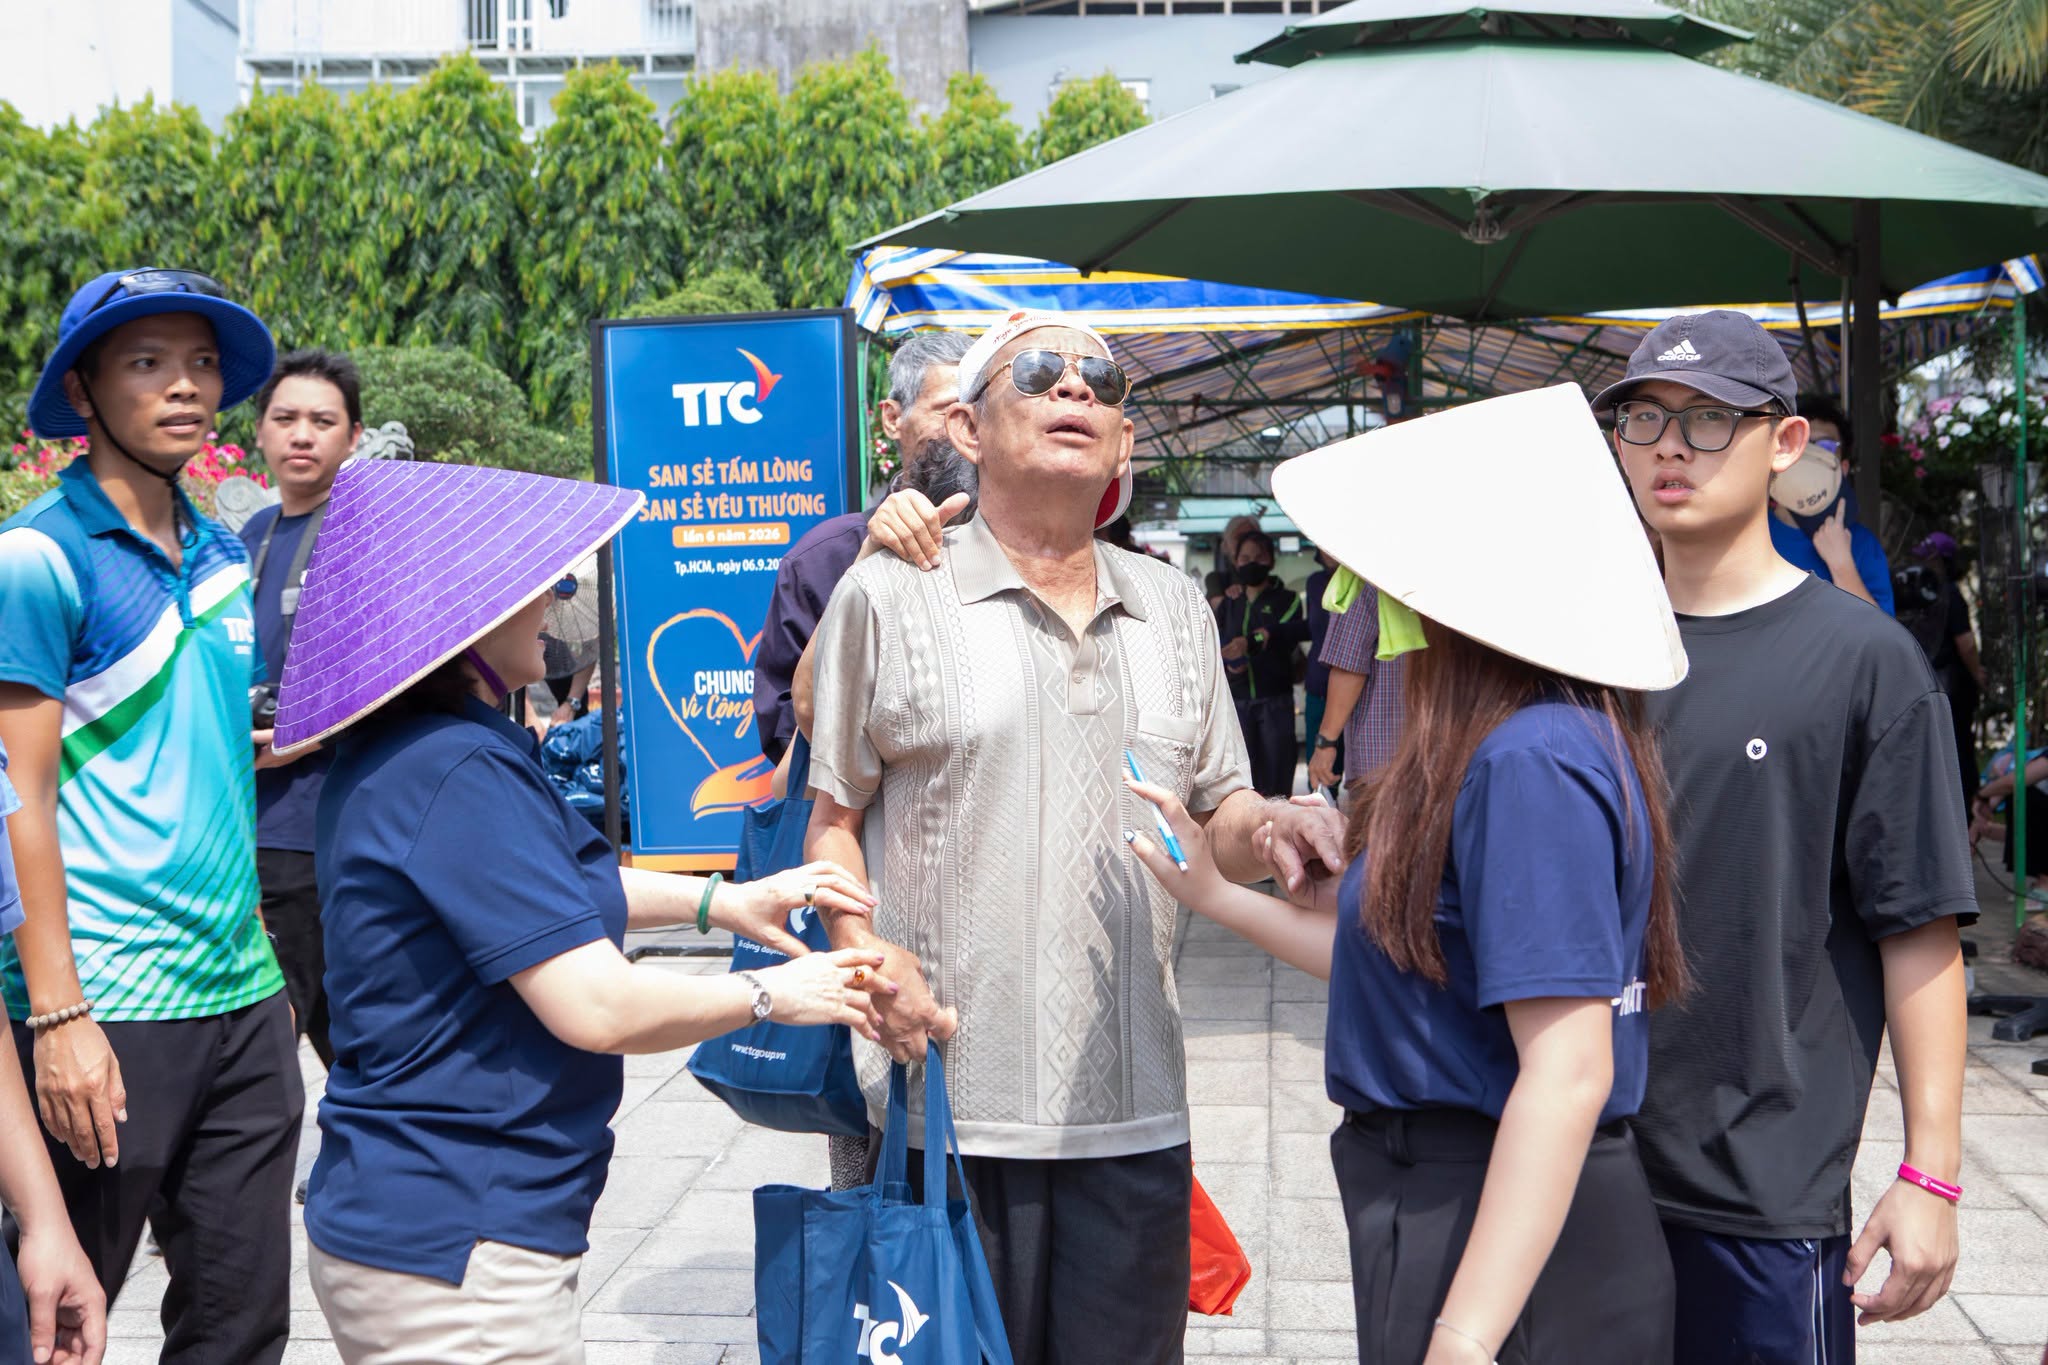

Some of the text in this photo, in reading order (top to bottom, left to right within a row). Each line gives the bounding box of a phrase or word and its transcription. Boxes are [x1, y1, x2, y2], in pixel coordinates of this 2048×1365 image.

[1657, 353, 1701, 361] adidas
[672, 381, 763, 427] TTC
[649, 456, 813, 488] SAN SẺ TẤM LÒNG
[681, 491, 704, 520] SẺ
[706, 493, 743, 519] YÊU
[746, 492, 826, 518] THƯƠNG
[706, 529, 716, 542] 6
[748, 527, 781, 541] 2026
[674, 559, 715, 577] Tp.HCM,
[716, 558, 741, 575] ngày
[694, 669, 755, 695] CHUNG
[706, 693, 755, 739] Cộng
